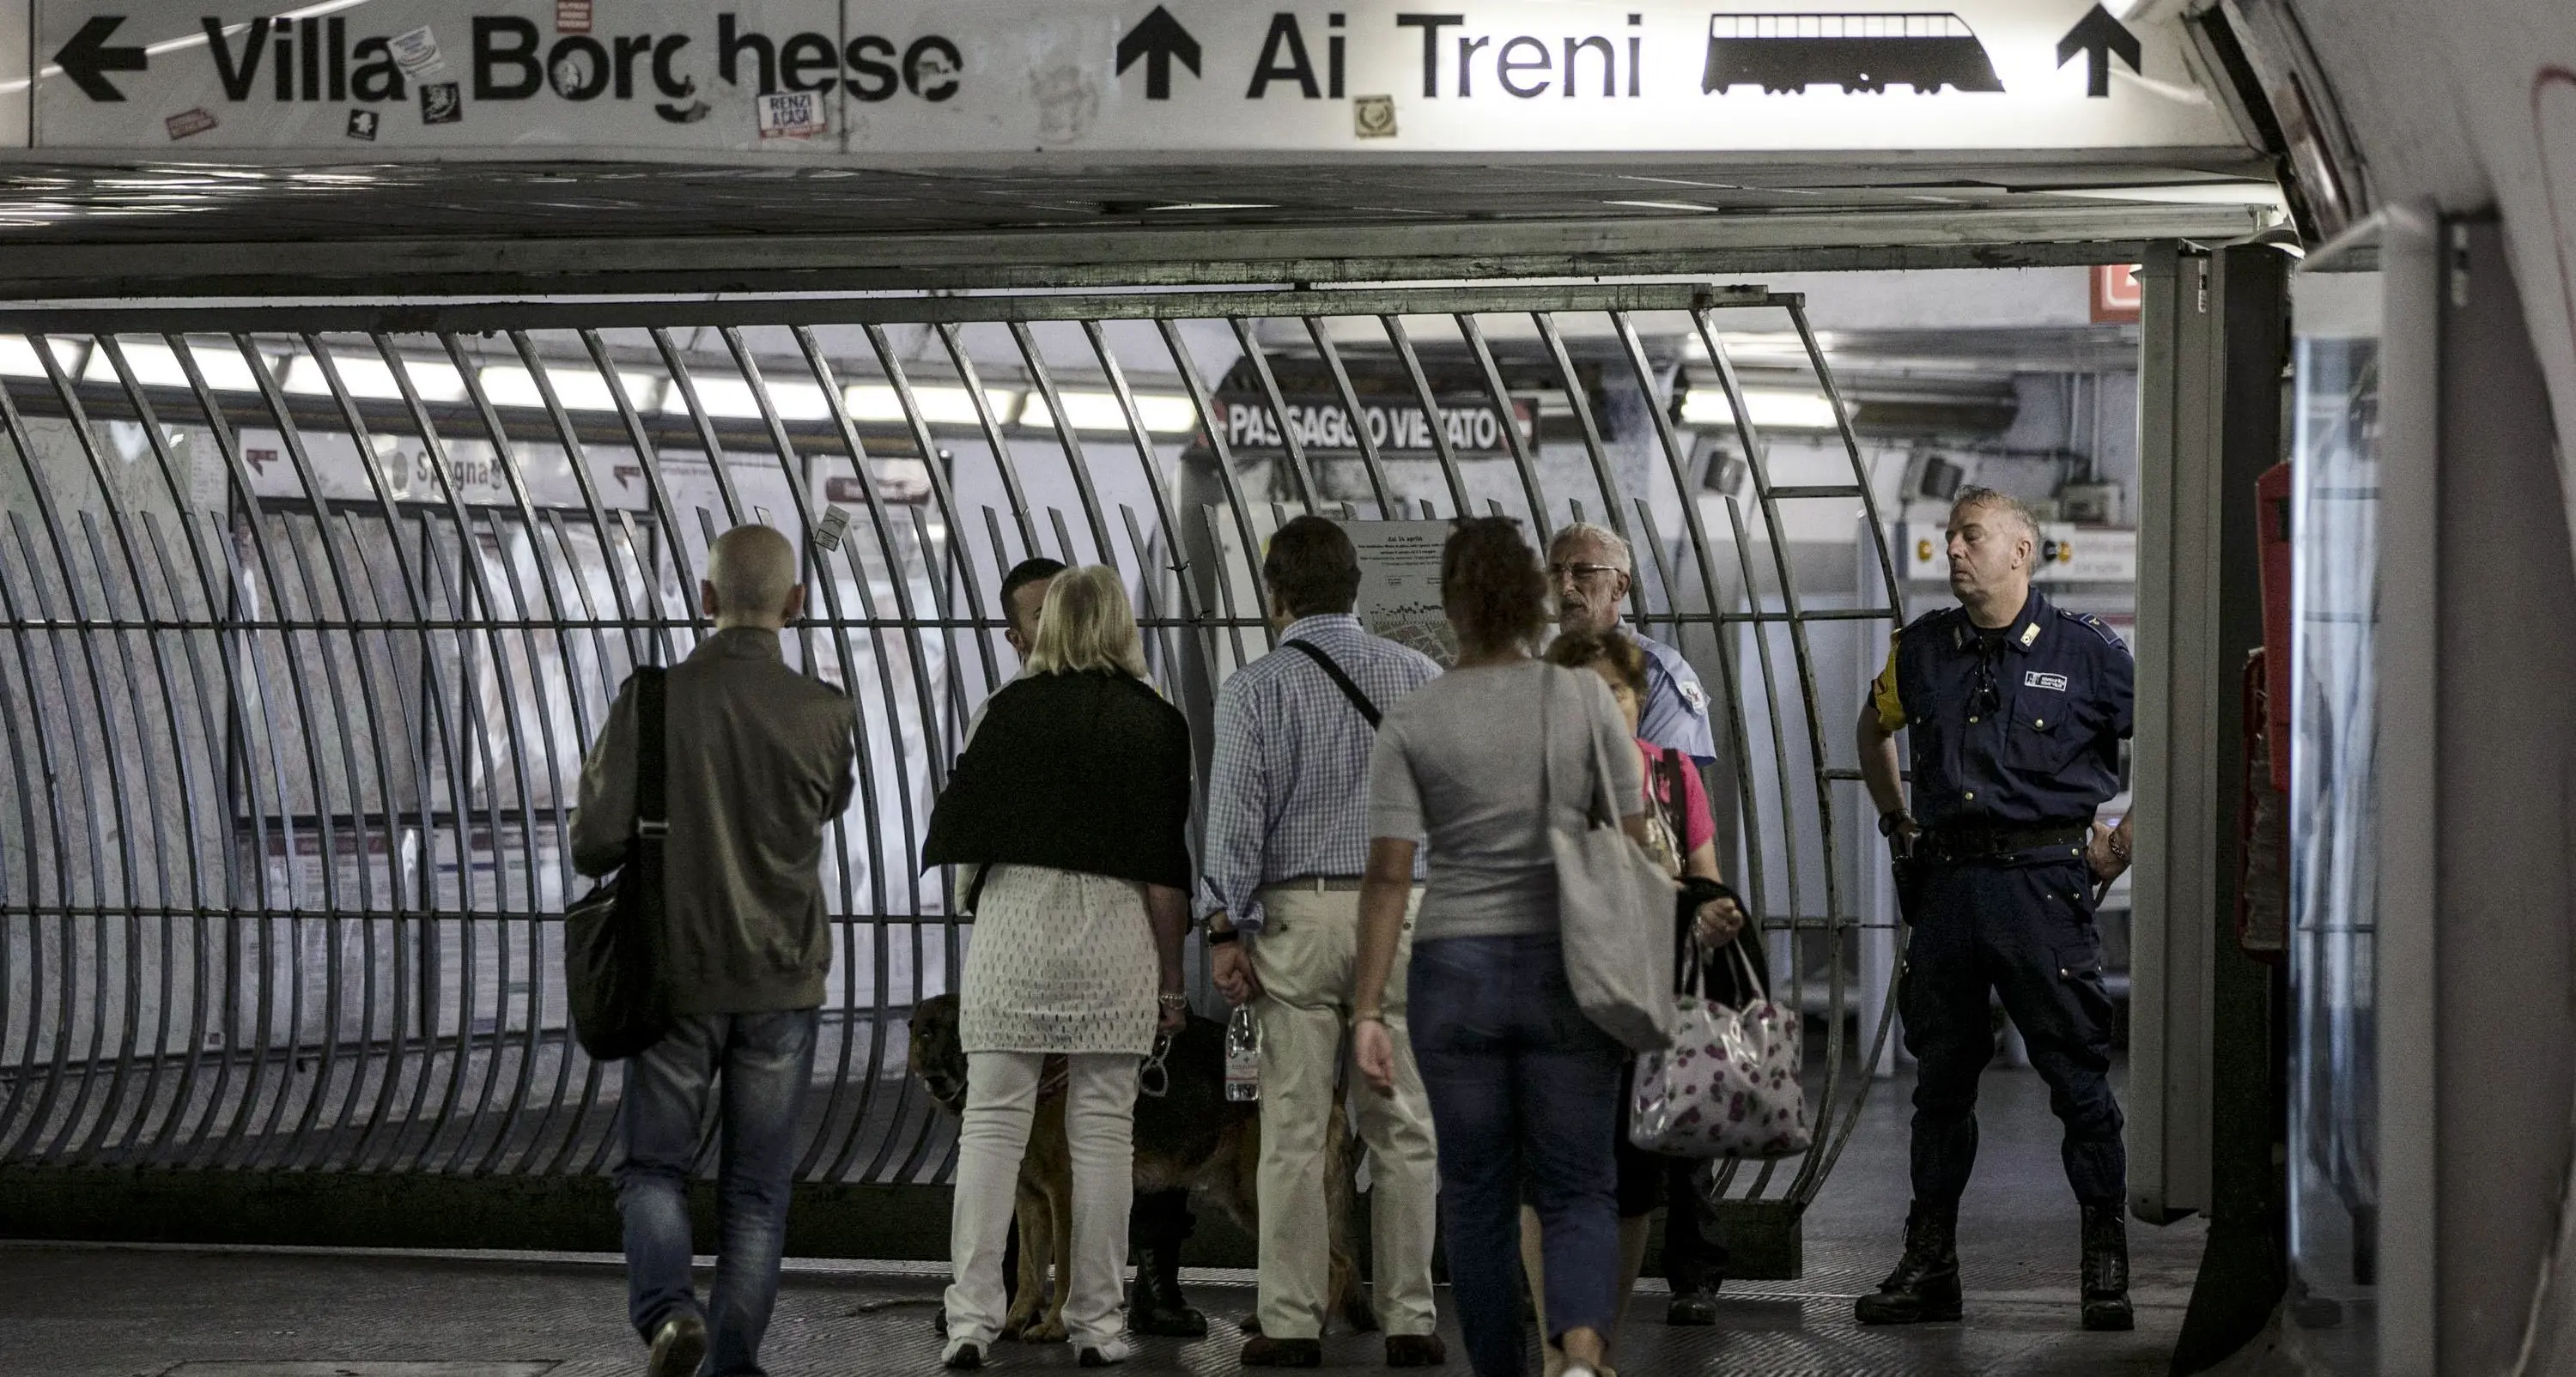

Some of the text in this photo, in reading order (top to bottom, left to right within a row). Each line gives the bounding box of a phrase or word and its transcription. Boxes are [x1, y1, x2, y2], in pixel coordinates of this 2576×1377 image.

[201, 13, 963, 124] Villa Borghese
[1245, 13, 1643, 99] Ai Treni
[770, 94, 811, 110] RENZI
[1229, 403, 1388, 447] PASSAGGO
[417, 451, 488, 492] Spgna
